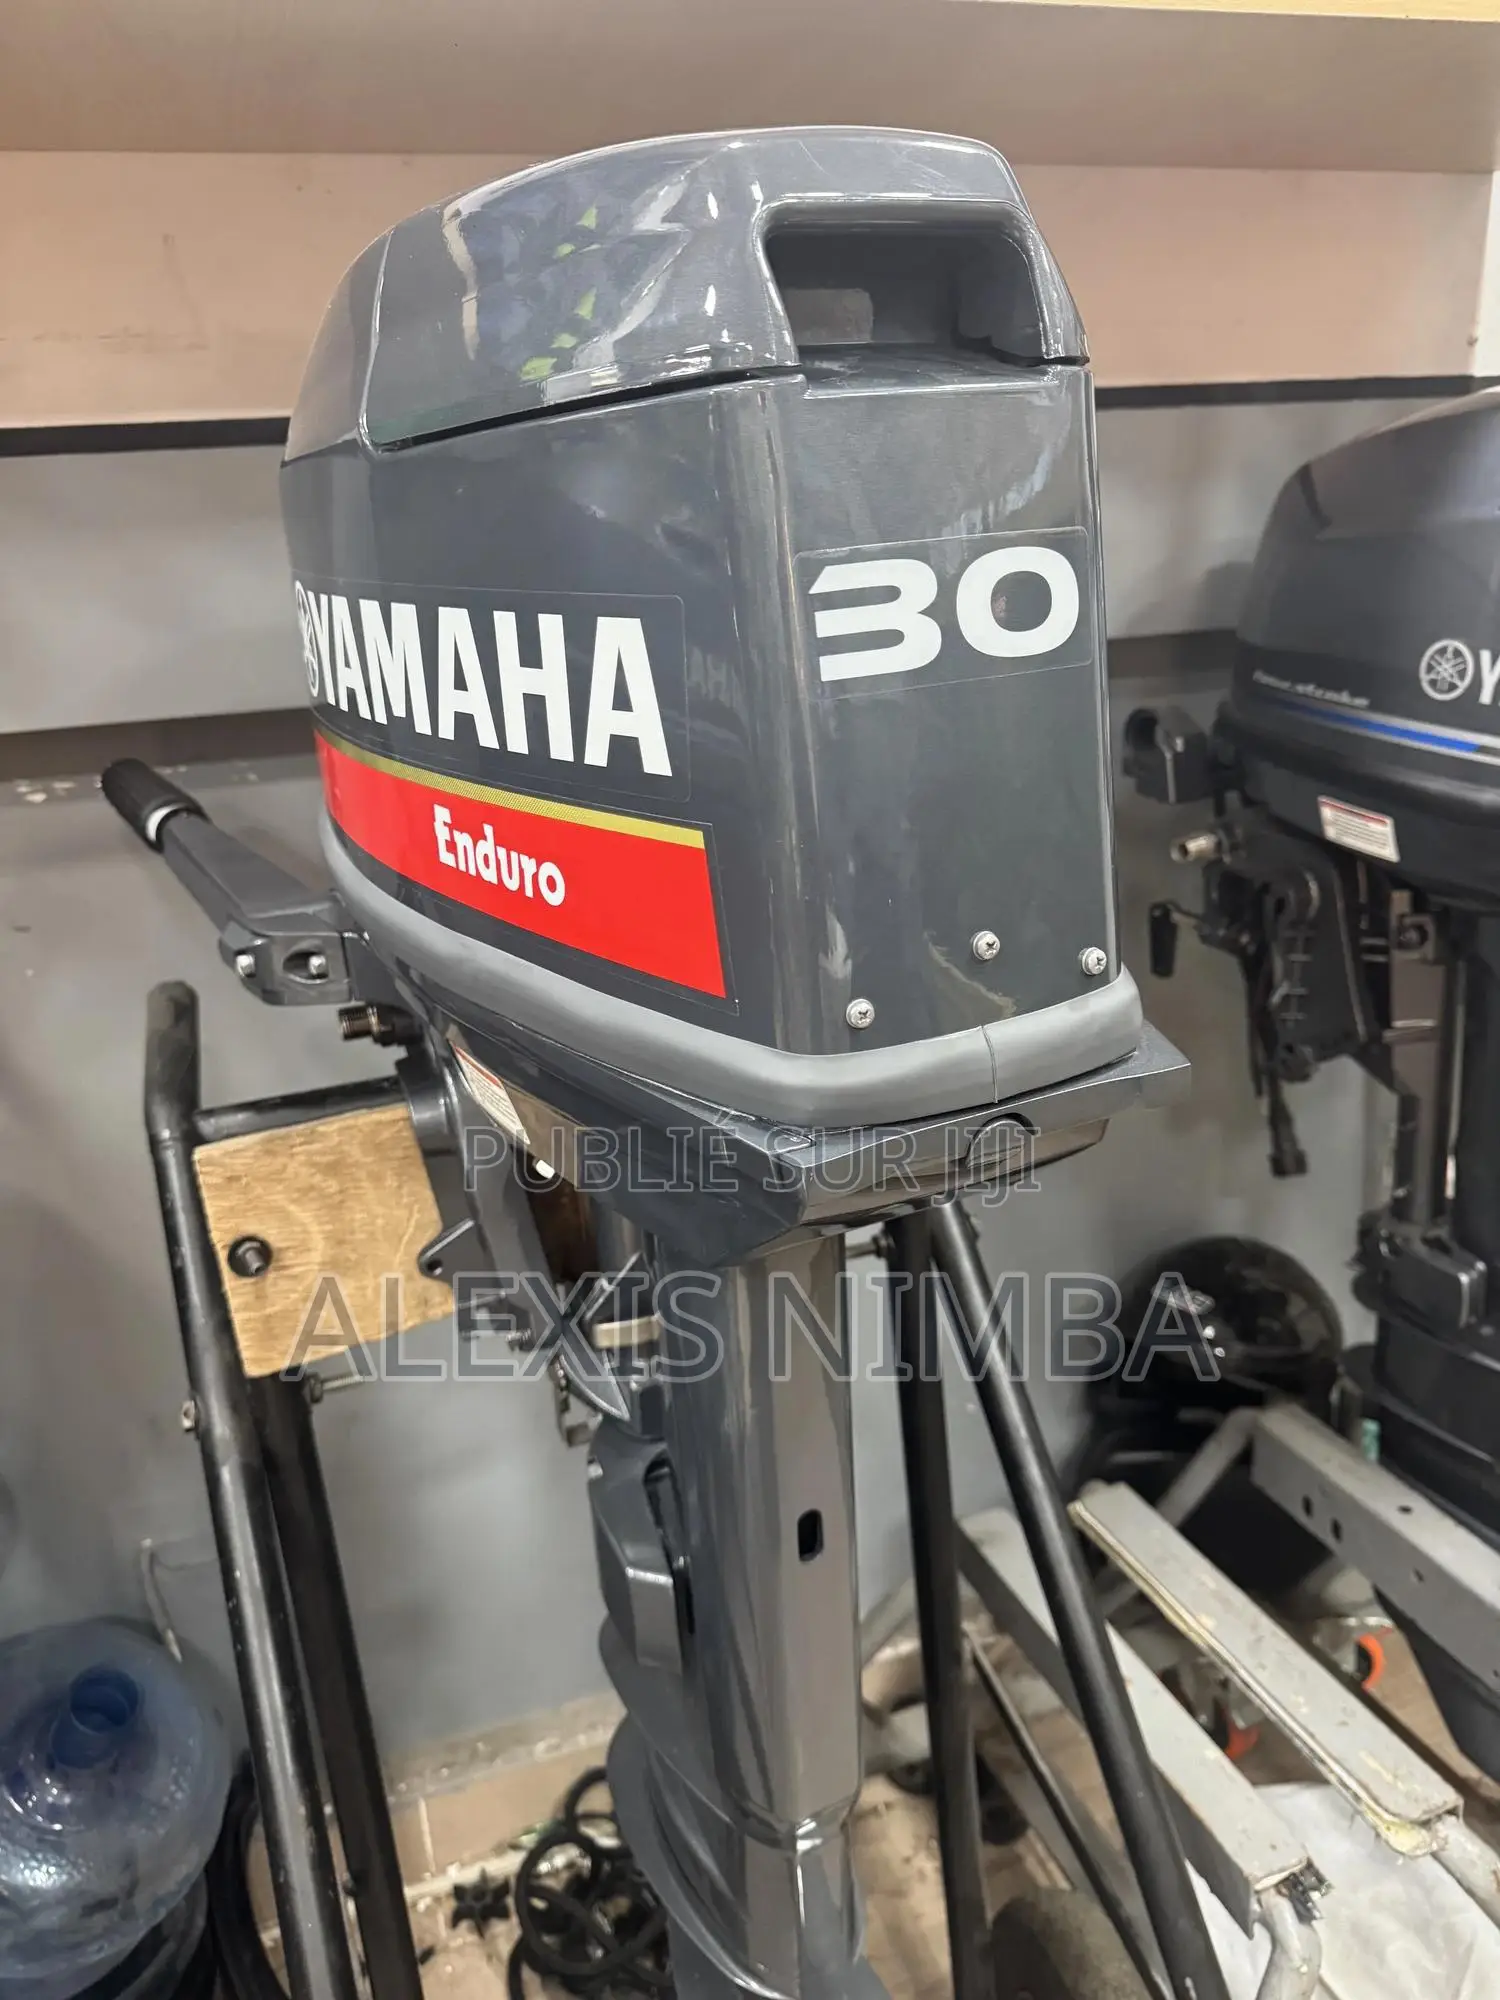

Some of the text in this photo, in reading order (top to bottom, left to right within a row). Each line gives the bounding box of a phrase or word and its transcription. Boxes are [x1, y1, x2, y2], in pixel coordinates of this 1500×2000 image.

[808, 546, 1080, 682] 30
[305, 590, 673, 777] YAMAHA
[433, 804, 566, 906] Enduro
